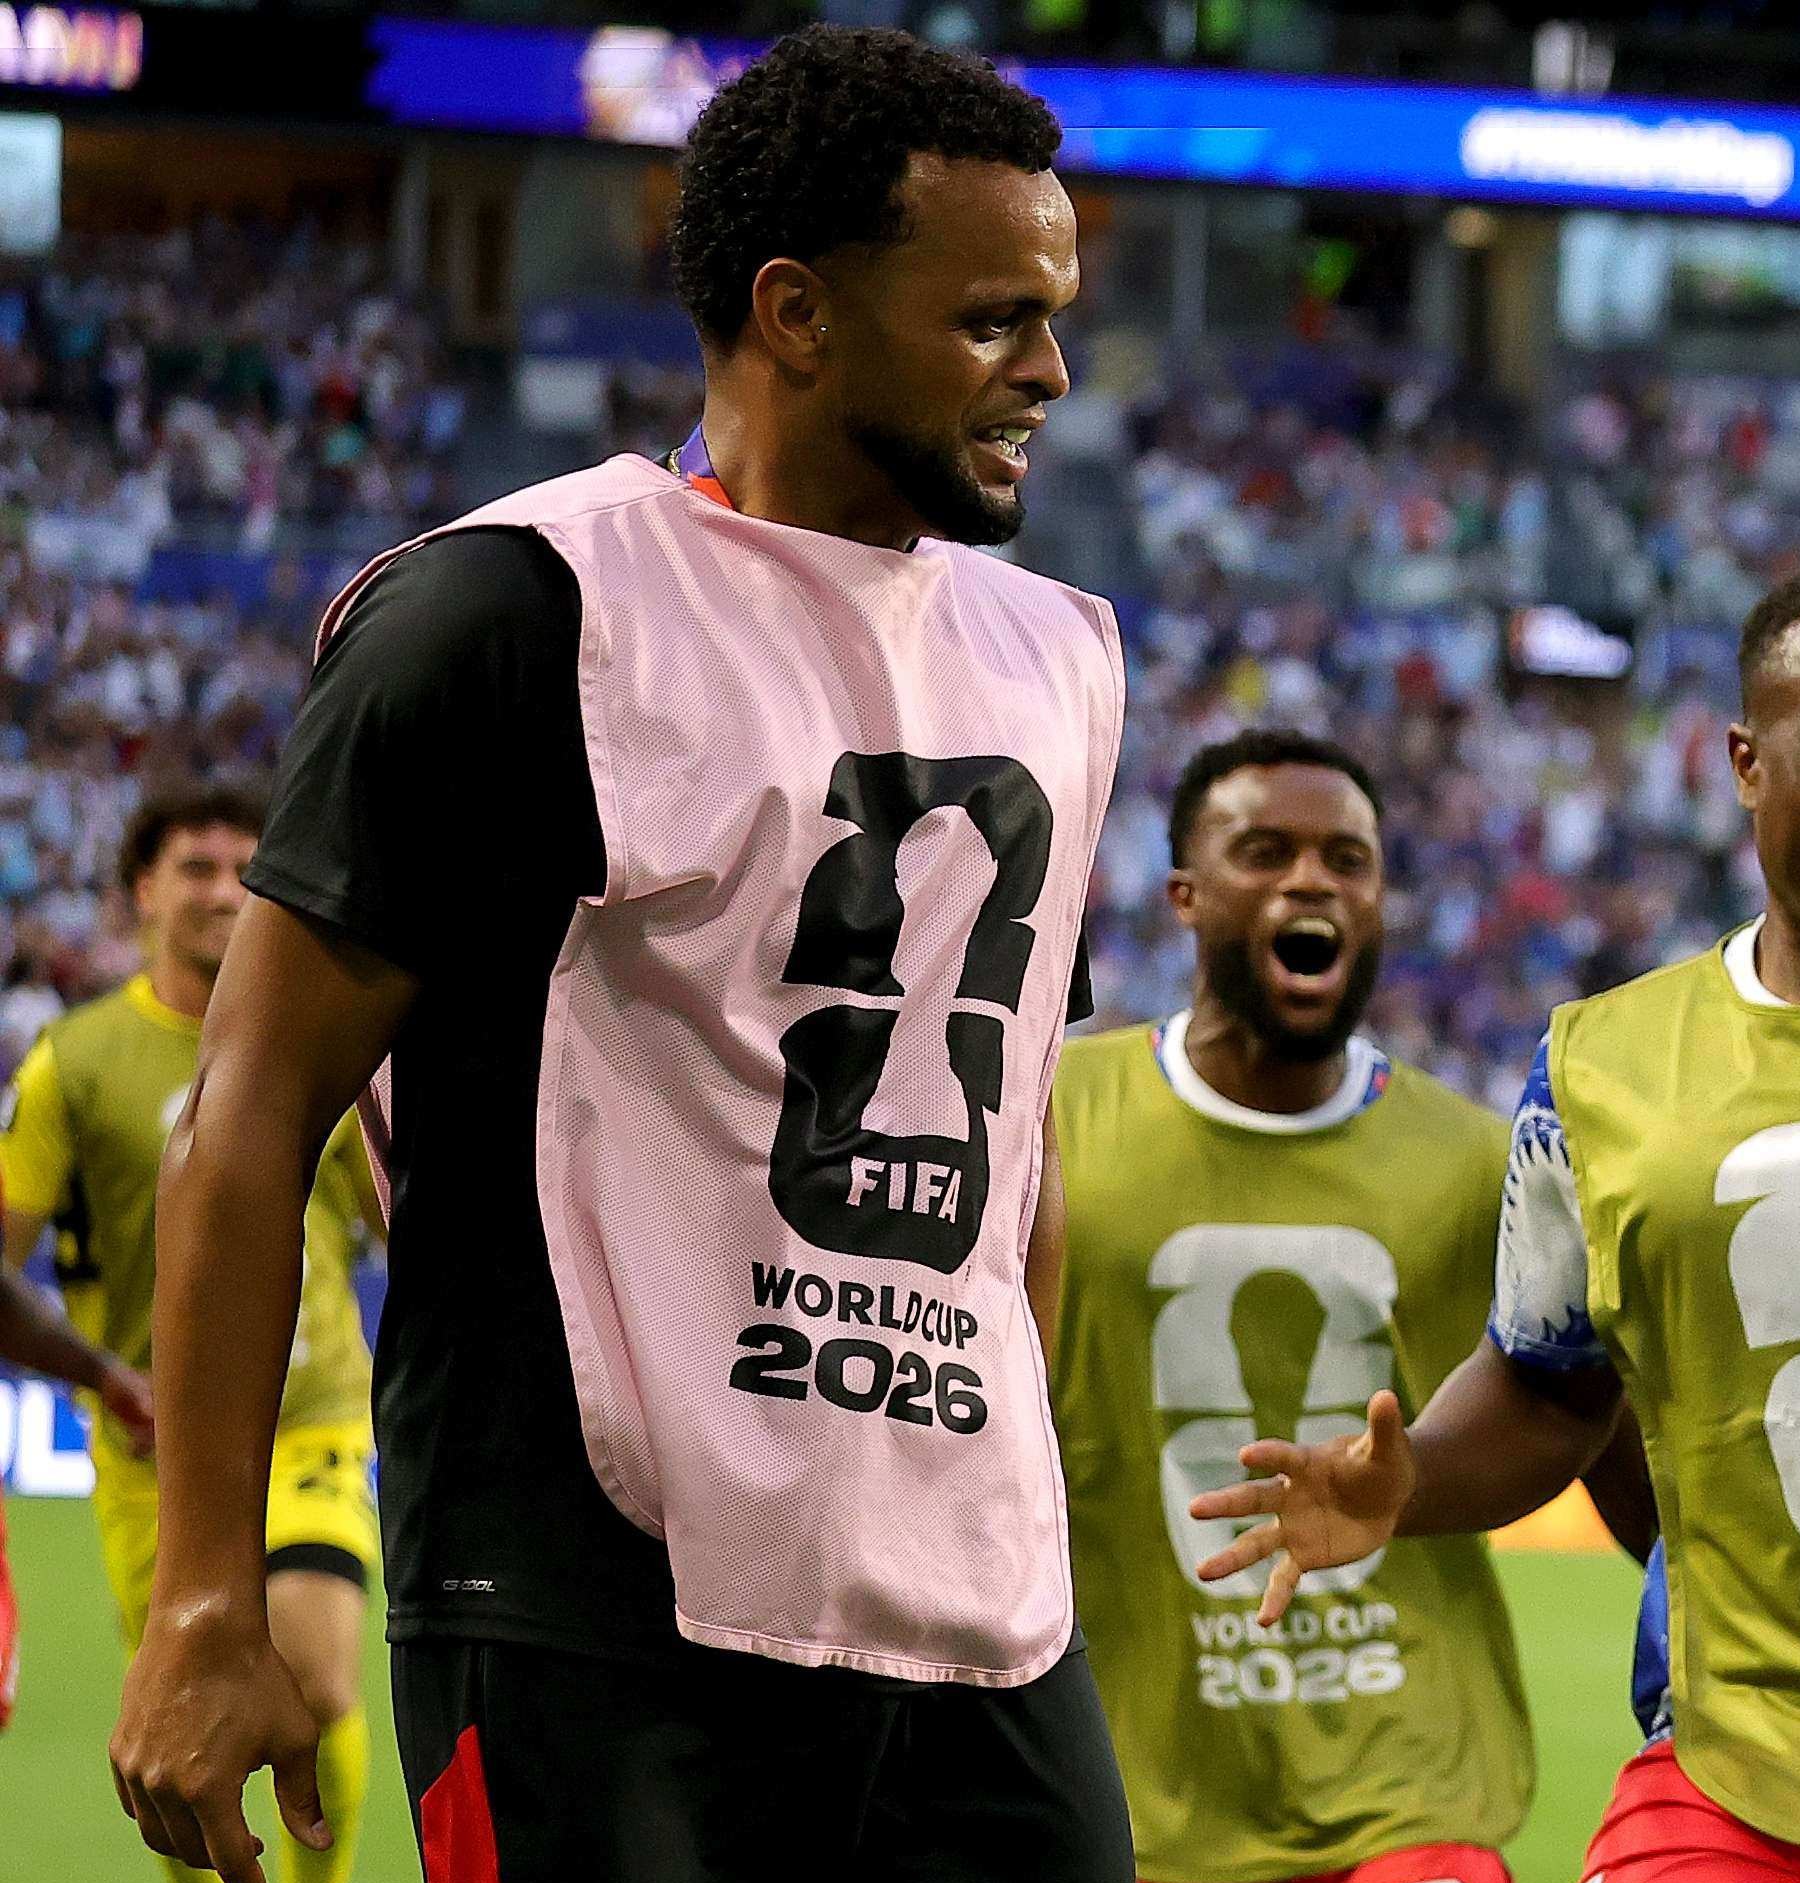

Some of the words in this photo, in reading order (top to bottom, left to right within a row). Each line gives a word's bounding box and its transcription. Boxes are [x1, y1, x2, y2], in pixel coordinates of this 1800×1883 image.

[846, 1155, 964, 1225] FIFA
[751, 1261, 920, 1334] WORLD
[921, 1298, 978, 1350] CUP
[728, 1323, 988, 1435] 2026
[1197, 1640, 1408, 1709] 2026
